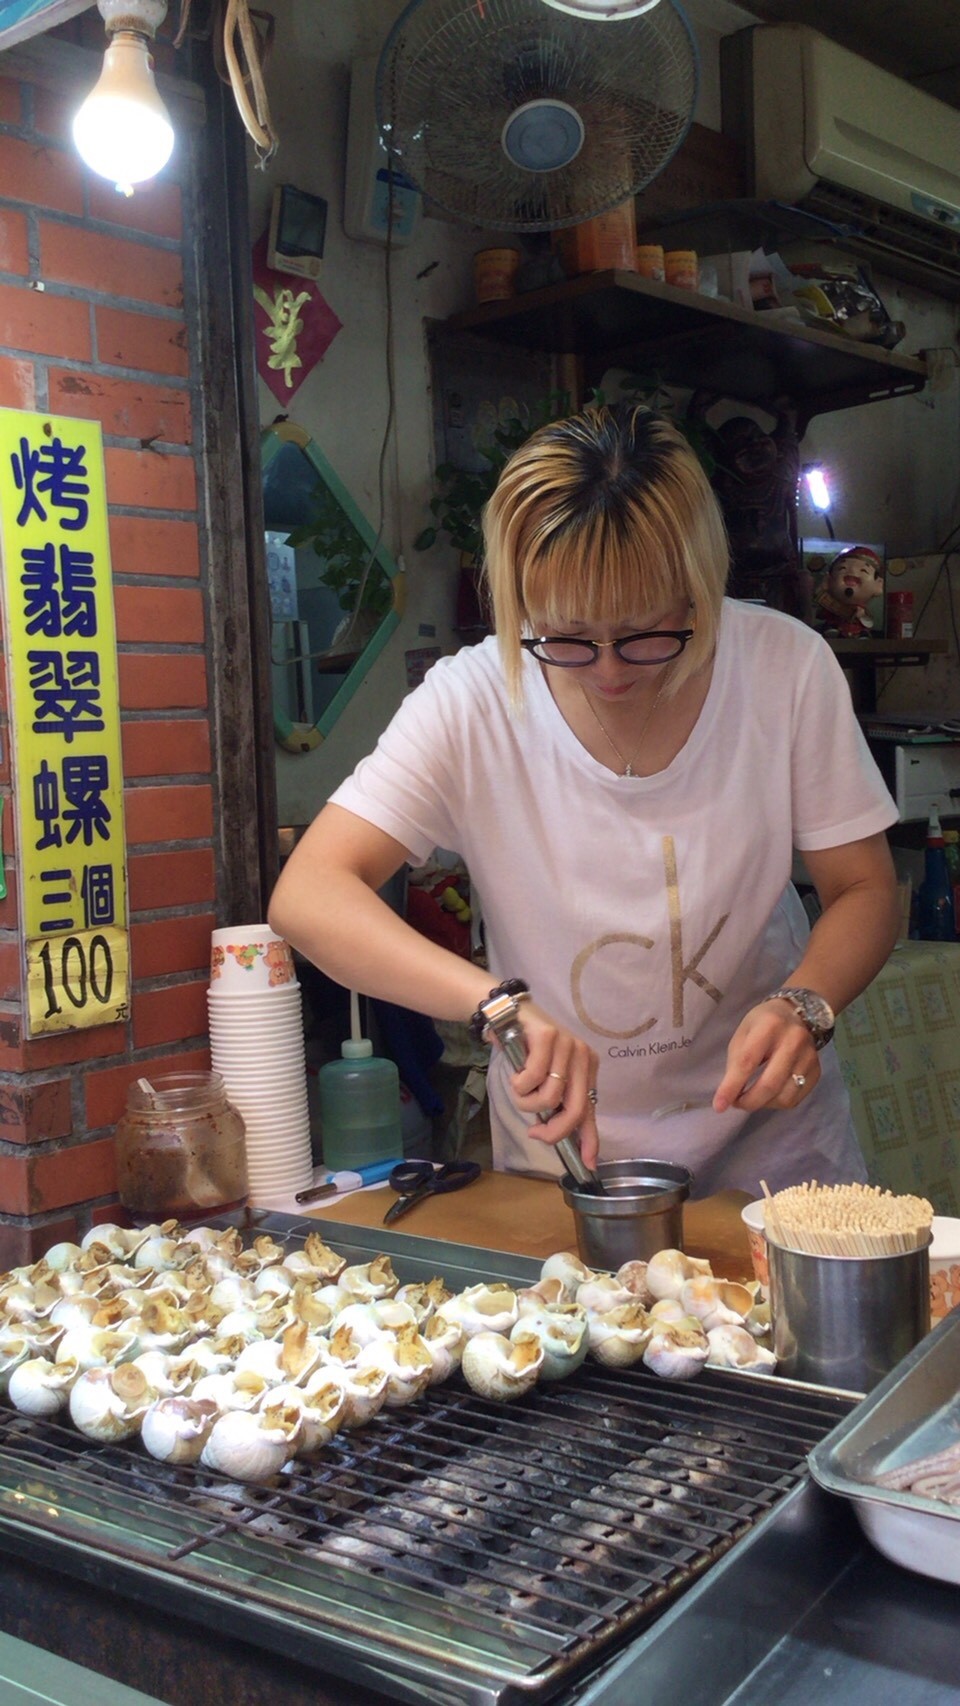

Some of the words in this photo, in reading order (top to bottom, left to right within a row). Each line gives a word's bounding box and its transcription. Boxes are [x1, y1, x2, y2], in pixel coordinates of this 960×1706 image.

[10, 437, 111, 850] 烤翡翠螺
[39, 864, 115, 932] 三個
[38, 934, 114, 1019] 100
[115, 1003, 129, 1021] 元
[608, 1045, 647, 1058] Calvin
[649, 1041, 677, 1055] Klein
